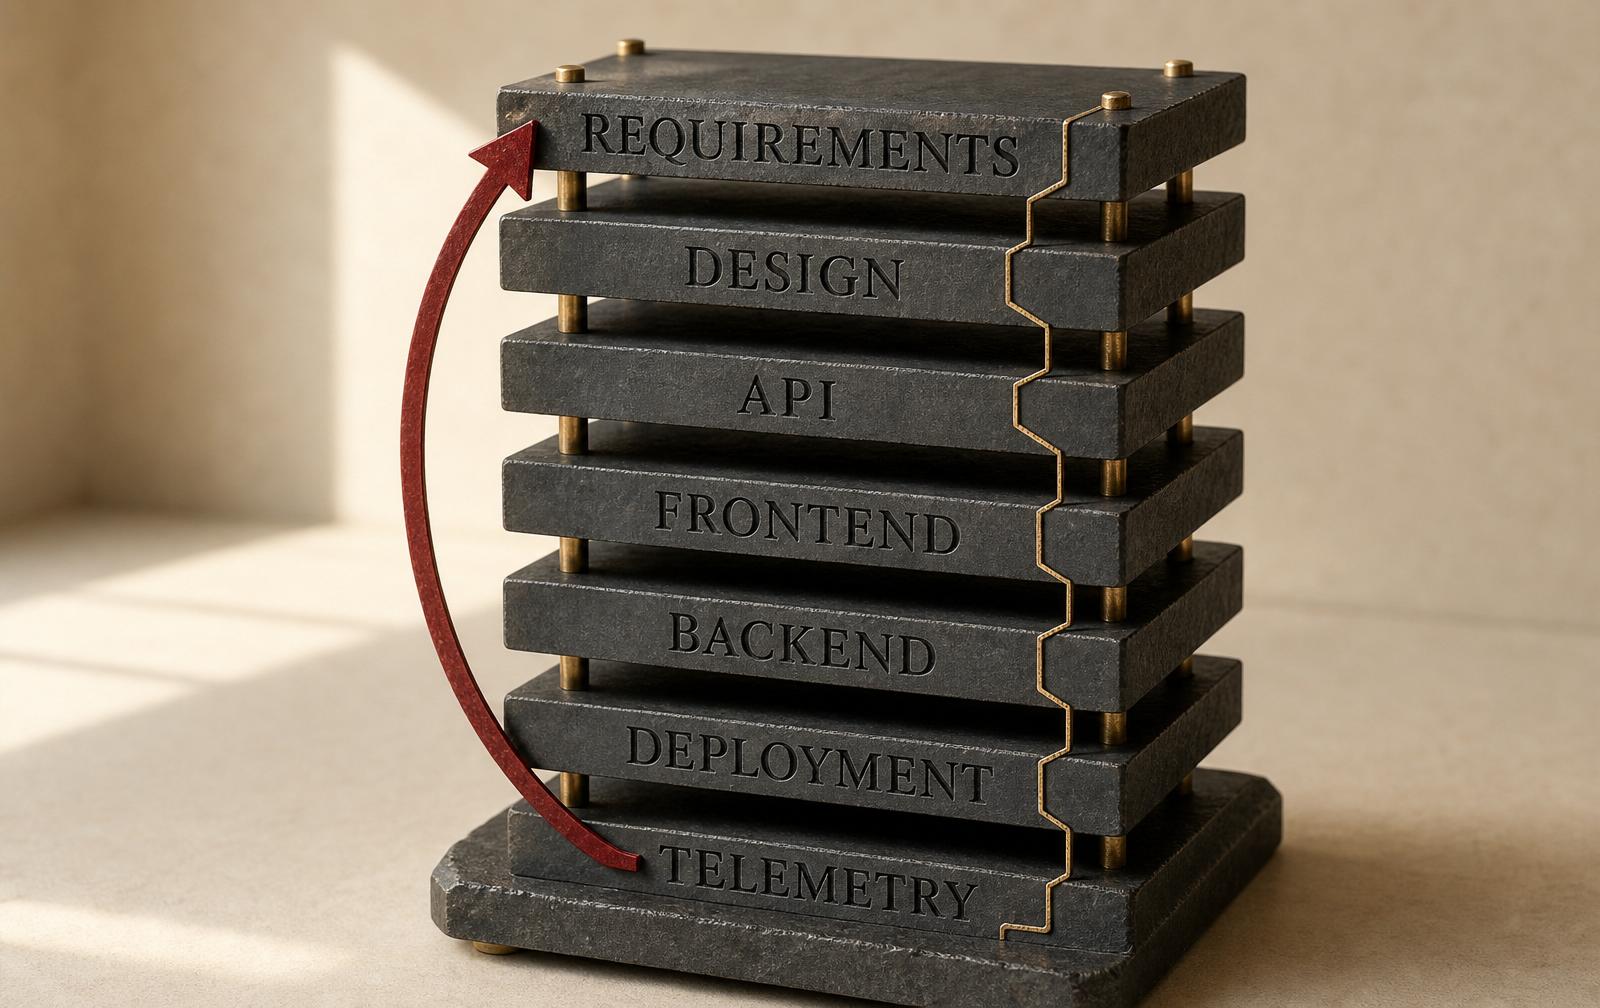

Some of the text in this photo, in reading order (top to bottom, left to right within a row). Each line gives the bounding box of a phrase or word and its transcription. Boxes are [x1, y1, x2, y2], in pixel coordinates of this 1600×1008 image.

[582, 112, 1020, 178] REQUIREMENTS
[685, 246, 906, 300] DESIGN
[737, 374, 836, 420] API
[655, 490, 961, 556] FRONTEND
[668, 612, 937, 677] BACKEND
[626, 726, 993, 805] DEPLOYMENT
[659, 845, 979, 922] TELEMETRY
